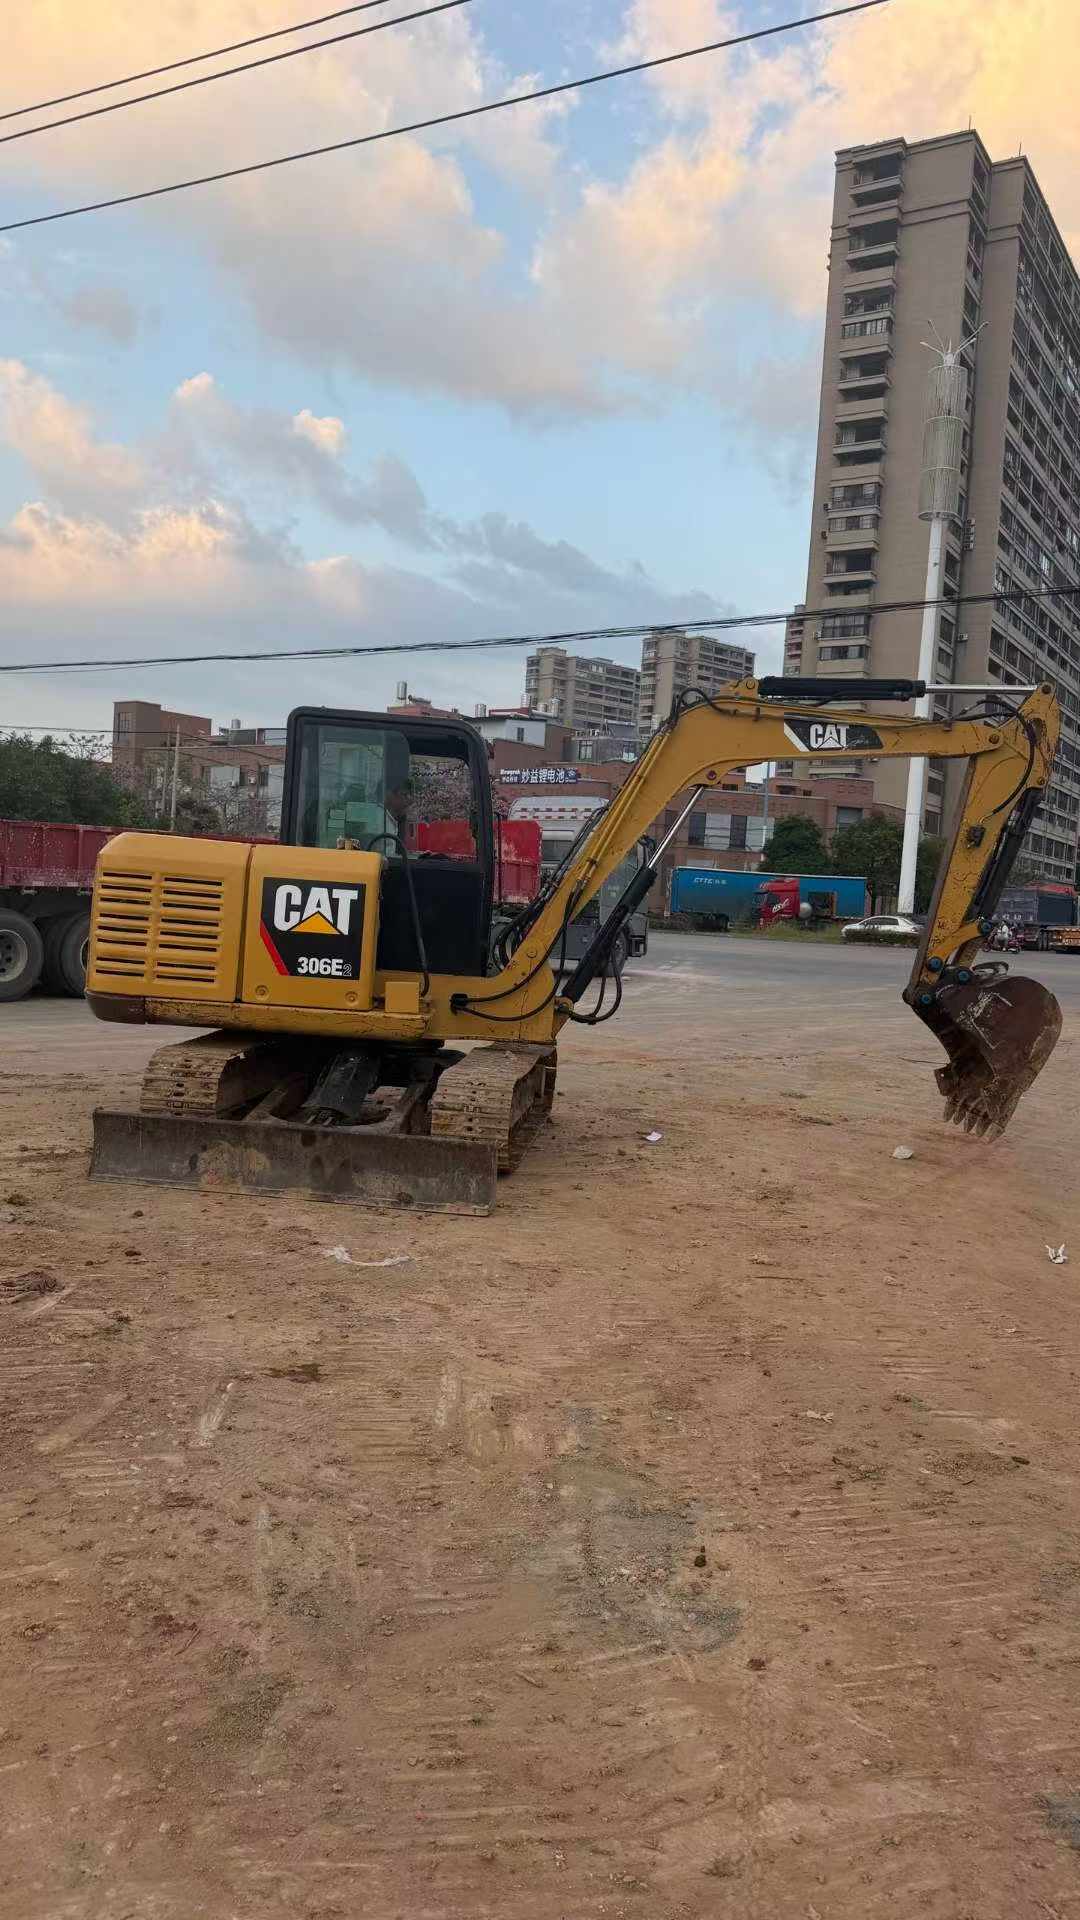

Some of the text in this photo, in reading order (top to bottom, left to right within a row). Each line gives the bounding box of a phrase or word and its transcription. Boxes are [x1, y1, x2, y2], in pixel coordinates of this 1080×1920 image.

[809, 723, 849, 749] CAT
[273, 884, 358, 935] CAT
[297, 956, 352, 977] 306E2
